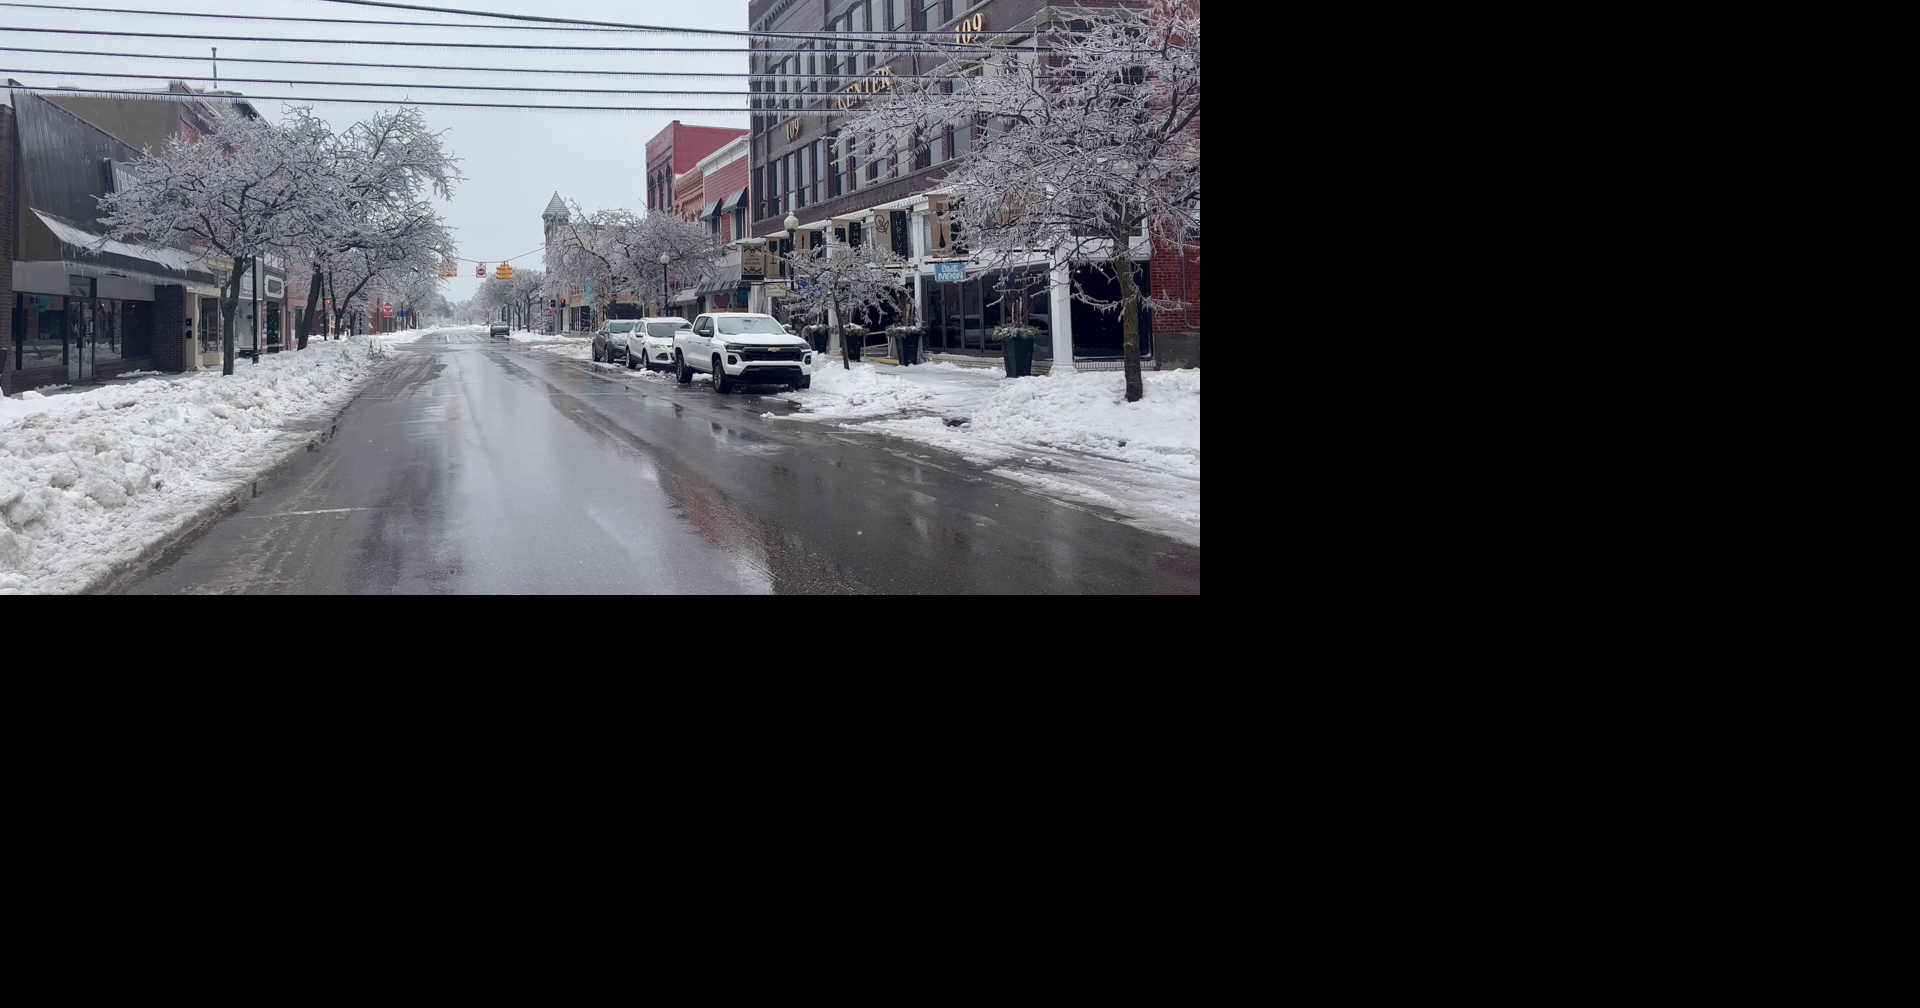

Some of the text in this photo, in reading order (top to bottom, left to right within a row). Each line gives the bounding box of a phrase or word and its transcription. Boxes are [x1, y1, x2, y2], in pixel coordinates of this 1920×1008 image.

[954, 13, 983, 44] 109
[786, 118, 800, 140] 109
[941, 264, 959, 272] BLUE
[938, 272, 964, 280] MOON
